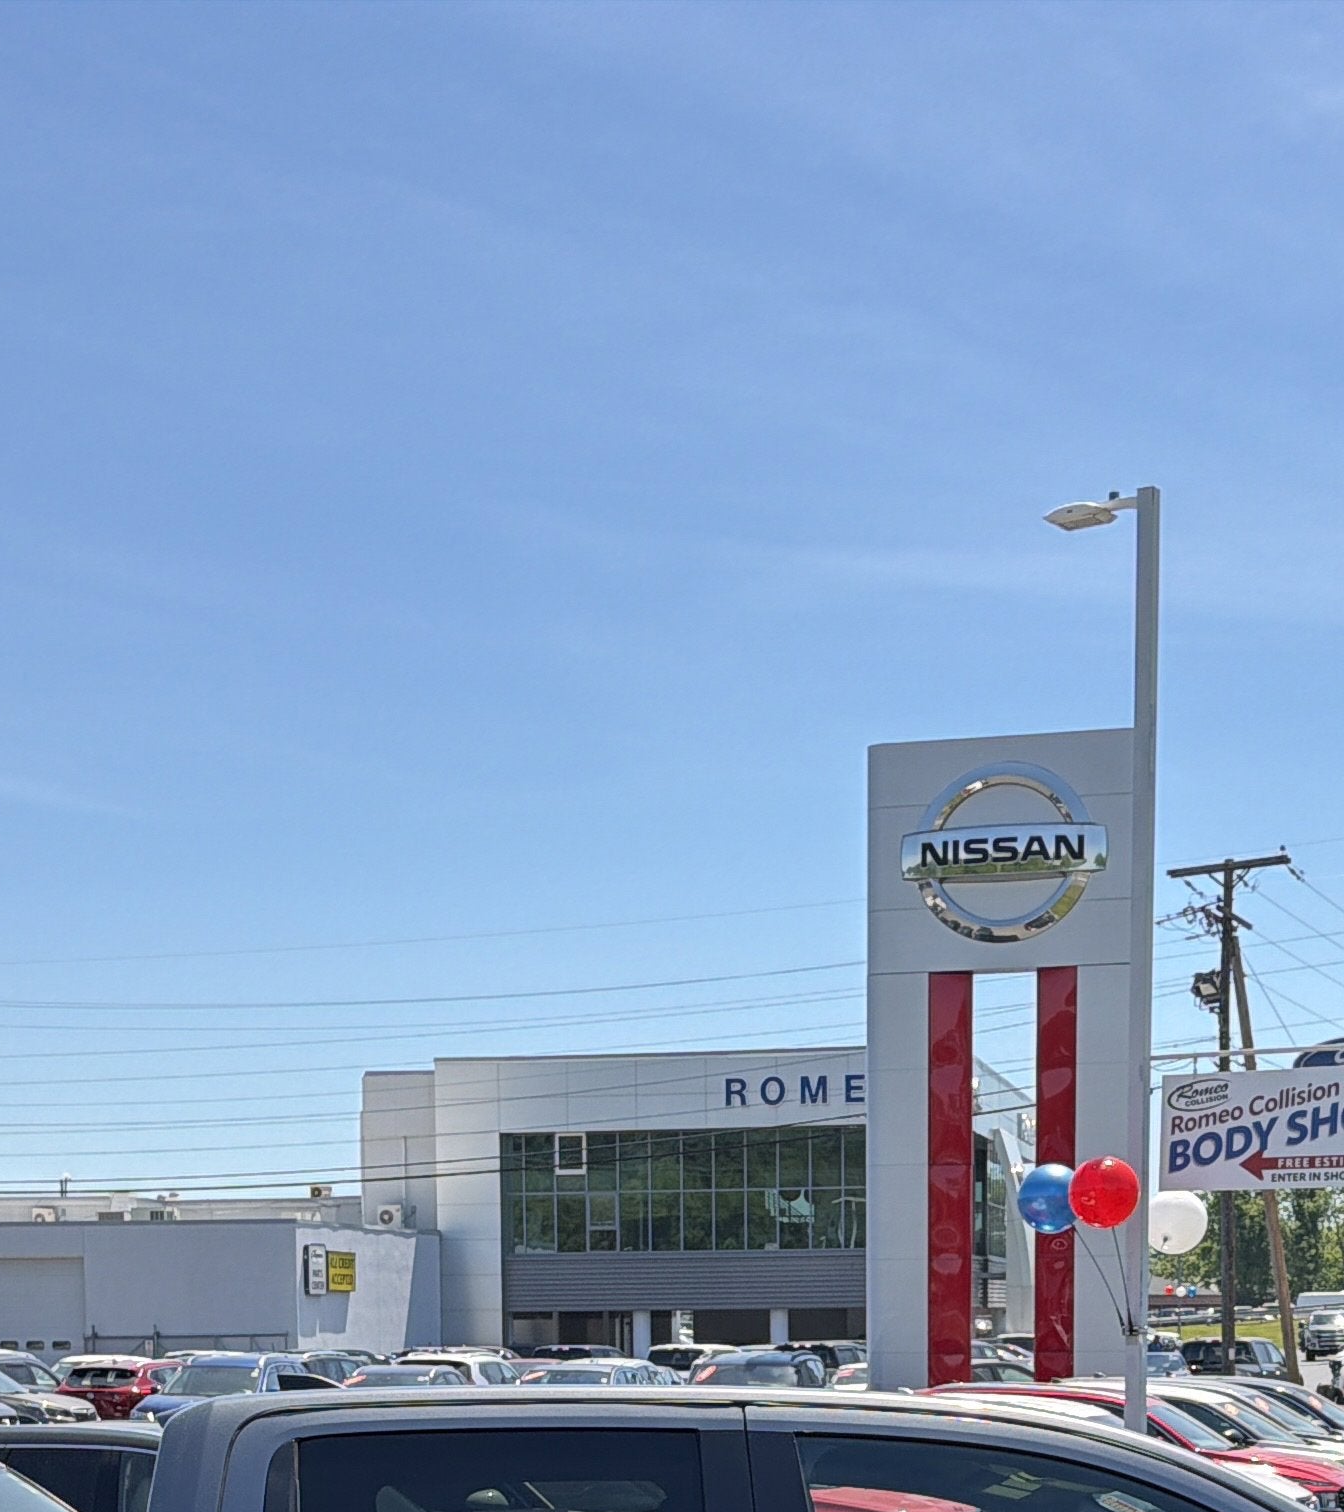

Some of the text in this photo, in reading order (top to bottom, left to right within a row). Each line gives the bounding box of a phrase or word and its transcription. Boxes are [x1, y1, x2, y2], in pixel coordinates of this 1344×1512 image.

[920, 834, 1085, 868] NISSAN
[725, 1073, 866, 1107] ROME
[1175, 1082, 1230, 1102] Romeo
[1184, 1093, 1229, 1108] COLLISION
[1170, 1081, 1340, 1136] Romeo Collision
[1168, 1116, 1280, 1174] BODY
[1277, 1157, 1310, 1169] FREE
[1270, 1171, 1306, 1183] ENTER
[1308, 1171, 1322, 1182] IN
